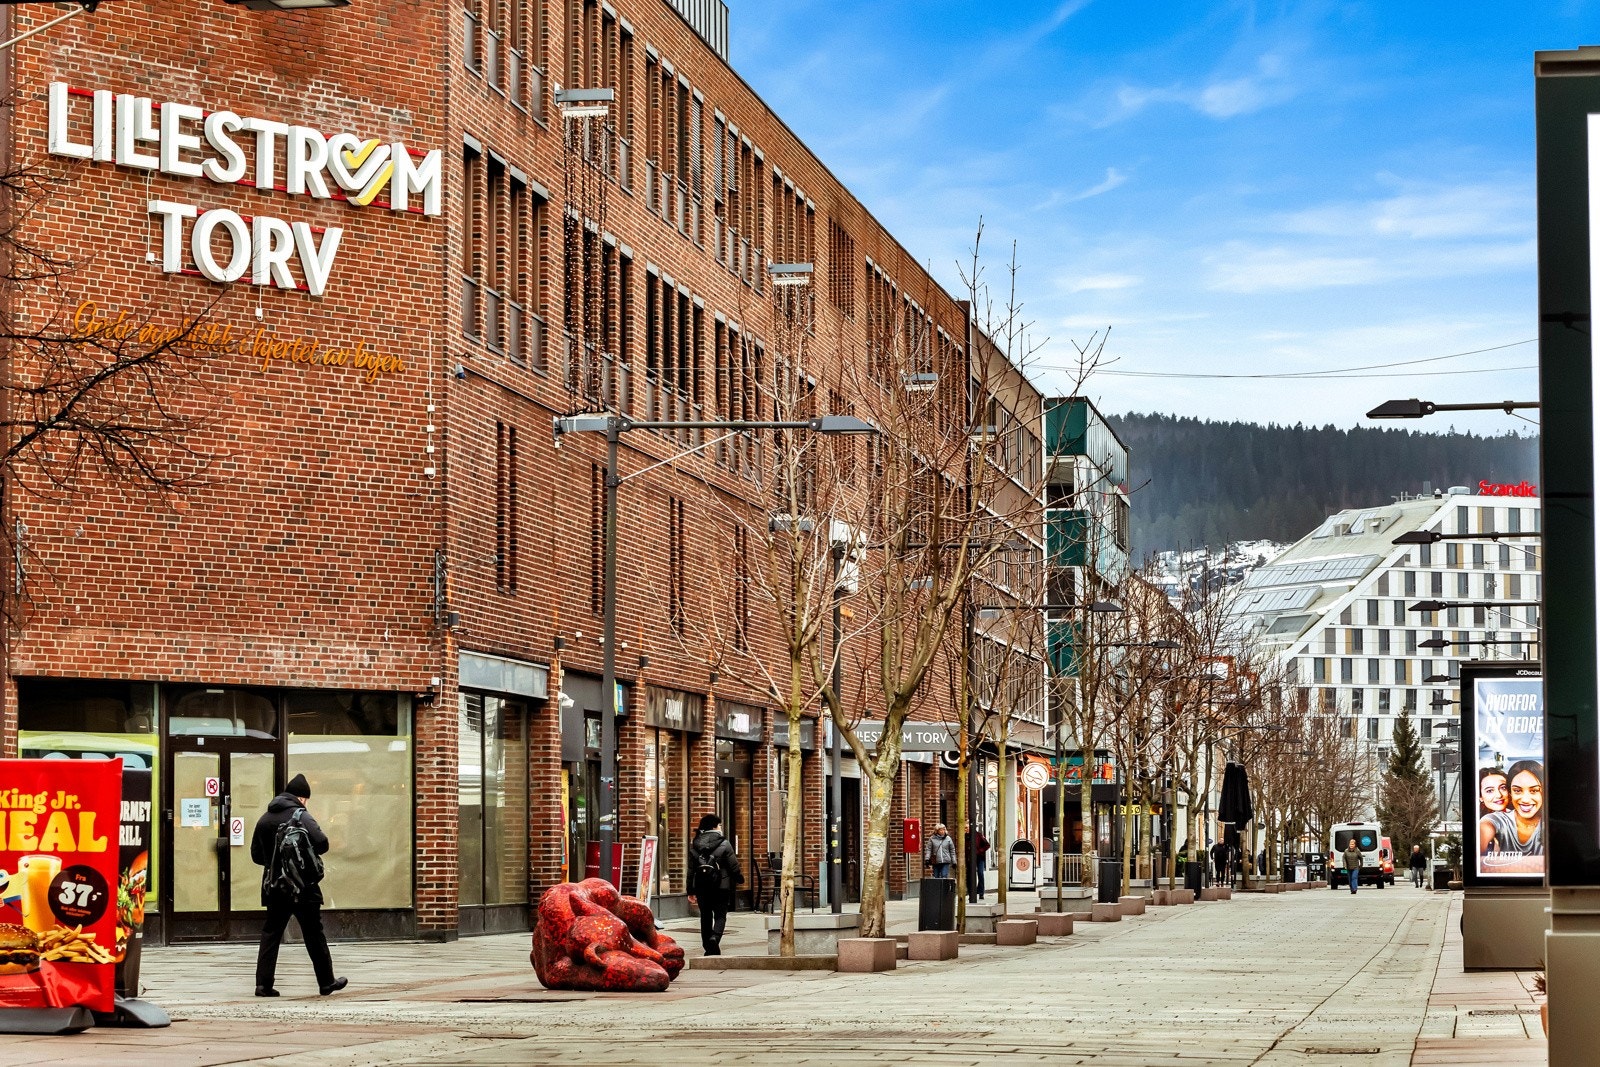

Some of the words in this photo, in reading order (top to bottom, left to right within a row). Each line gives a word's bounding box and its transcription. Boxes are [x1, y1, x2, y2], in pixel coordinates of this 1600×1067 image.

[149, 200, 343, 296] TORV
[252, 327, 320, 372] hjertet
[323, 348, 350, 366] av
[354, 340, 406, 384] byen
[1478, 479, 1537, 498] Scandic
[1485, 693, 1537, 711] HVORFOR
[1485, 716, 1505, 733] FLY
[1506, 716, 1543, 734] BEDRE
[915, 732, 948, 744] TORV
[0, 788, 48, 814] King
[51, 790, 81, 810] Jr.
[1487, 851, 1500, 861] FLY
[1500, 851, 1523, 861] BETTER
